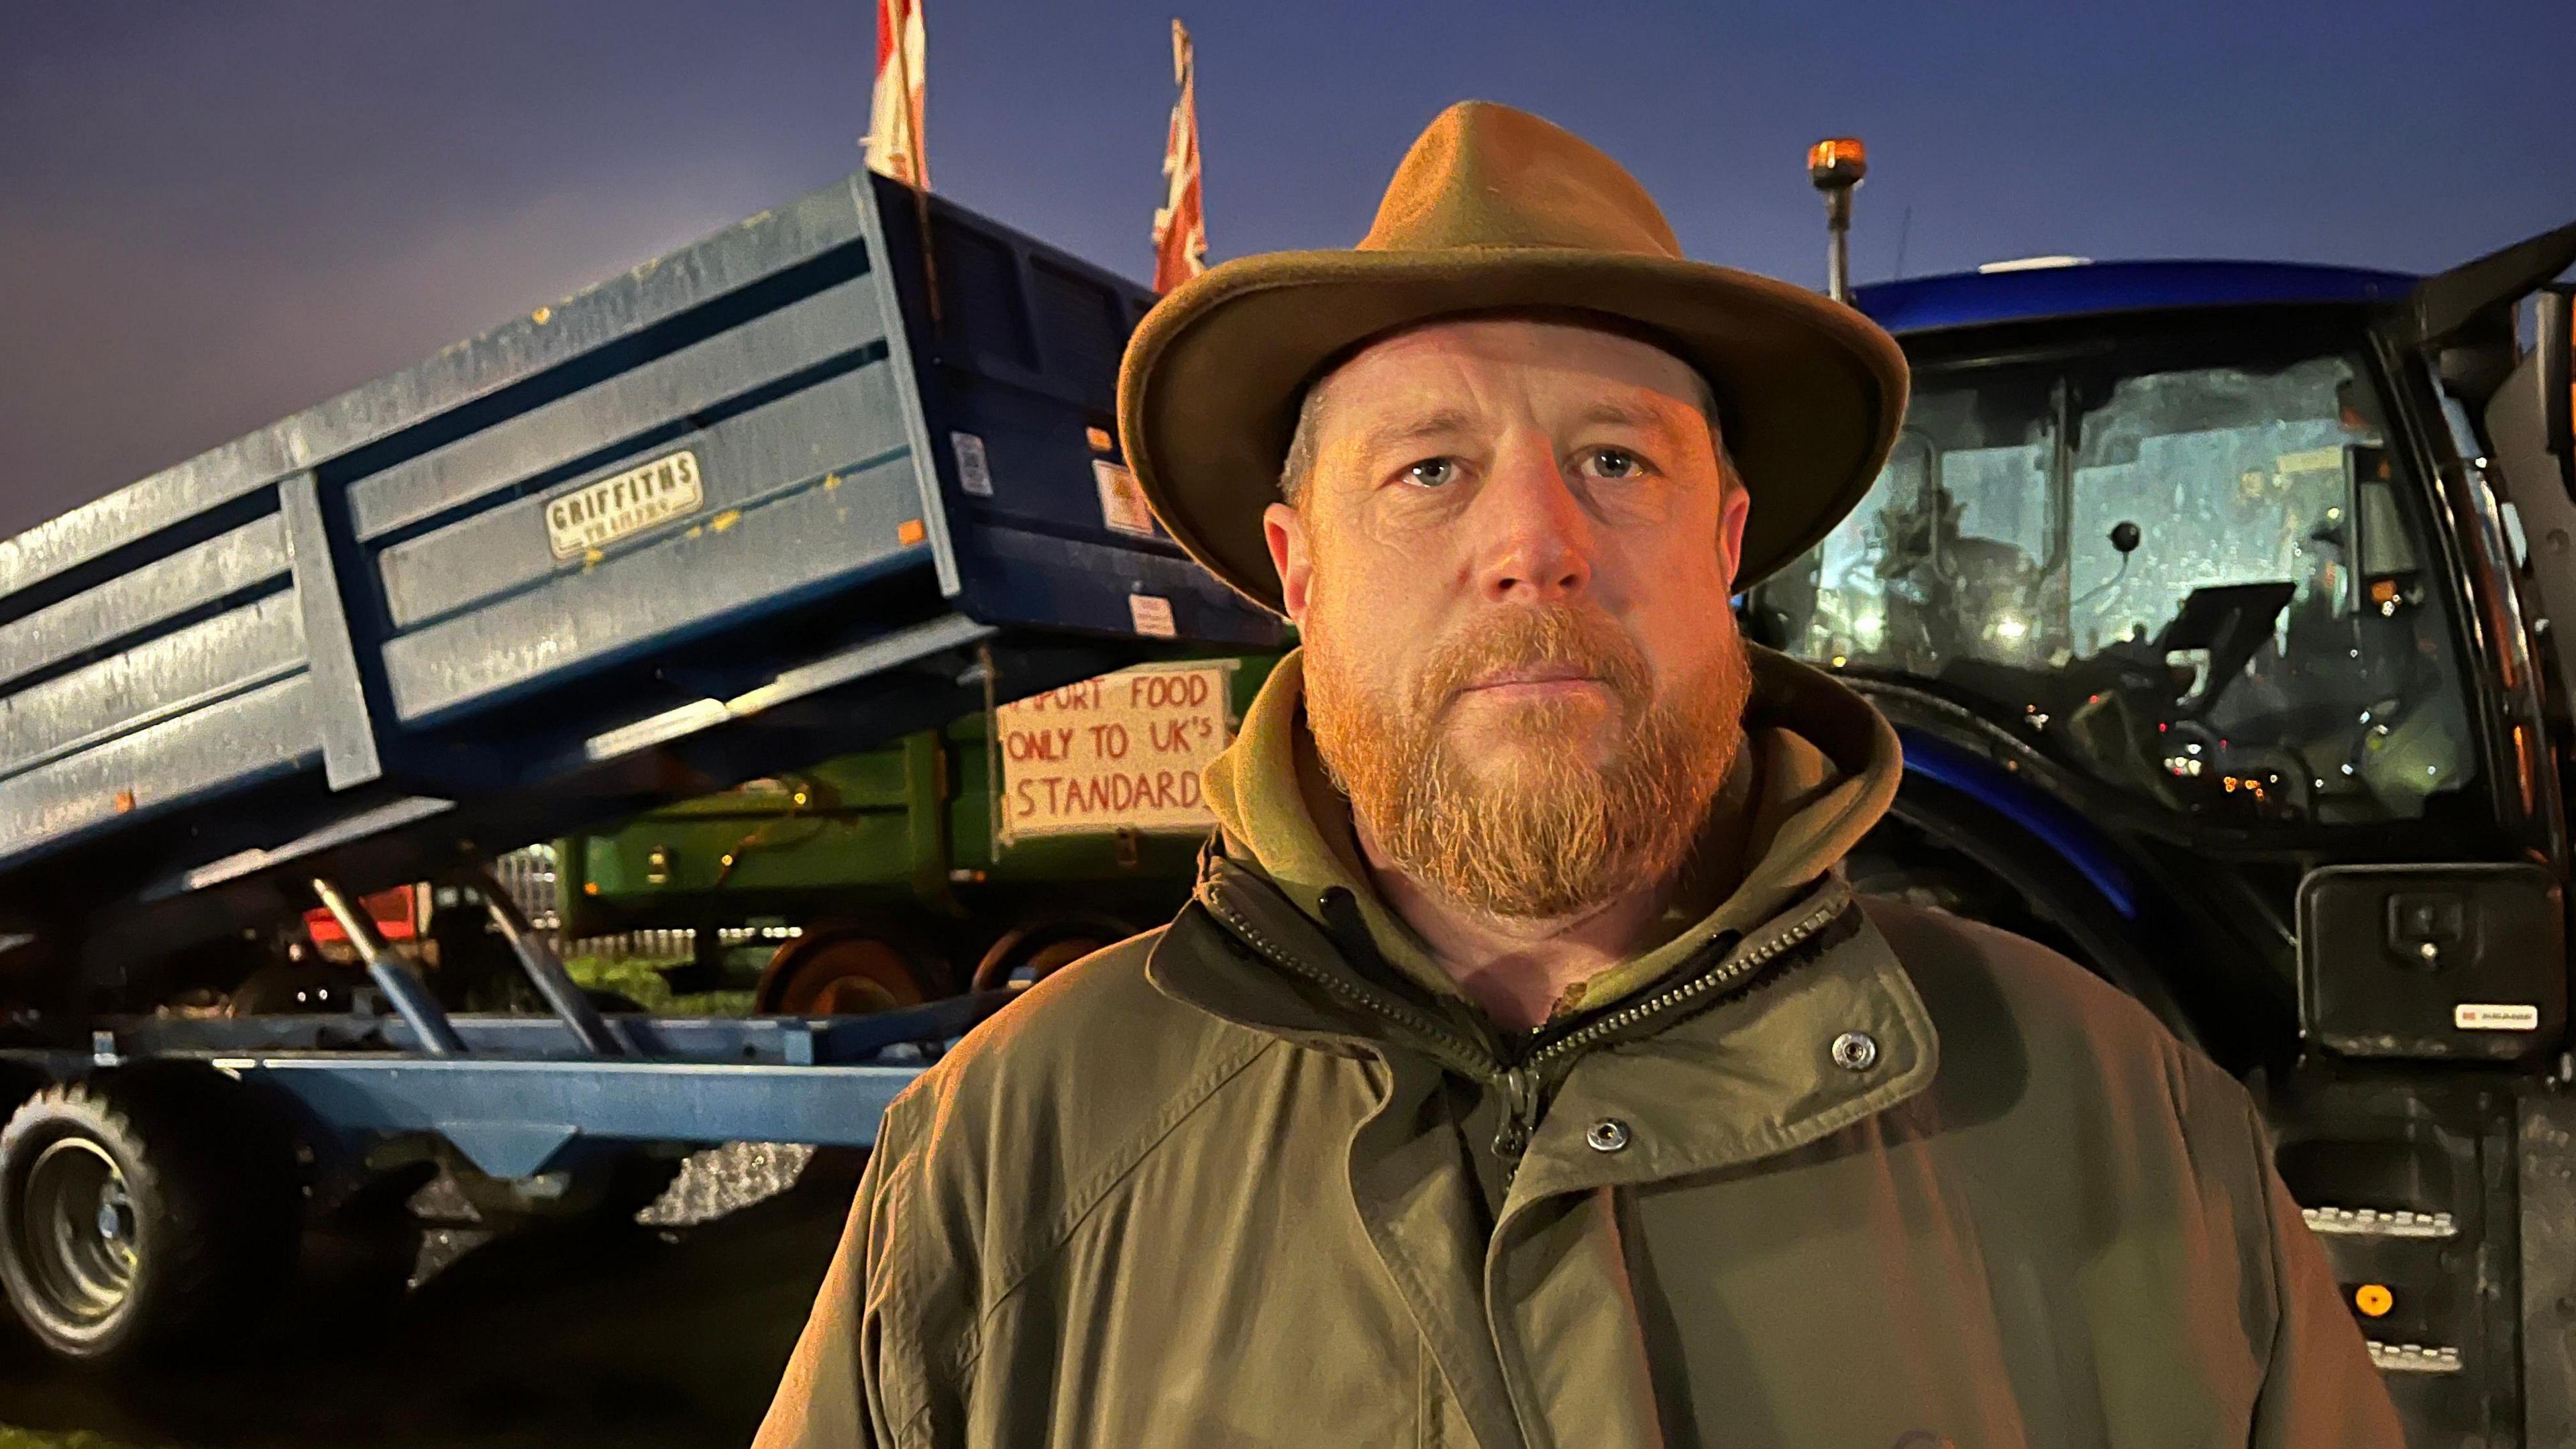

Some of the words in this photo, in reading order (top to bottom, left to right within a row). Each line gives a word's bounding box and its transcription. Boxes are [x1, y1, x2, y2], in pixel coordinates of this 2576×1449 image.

[552, 458, 692, 531] GRIFFITHS
[1008, 677, 1106, 712] PORT
[1131, 674, 1208, 708] FOOD
[1007, 728, 1073, 762] ONLY
[1089, 722, 1129, 759] TO
[1016, 769, 1201, 817] STANDARD
